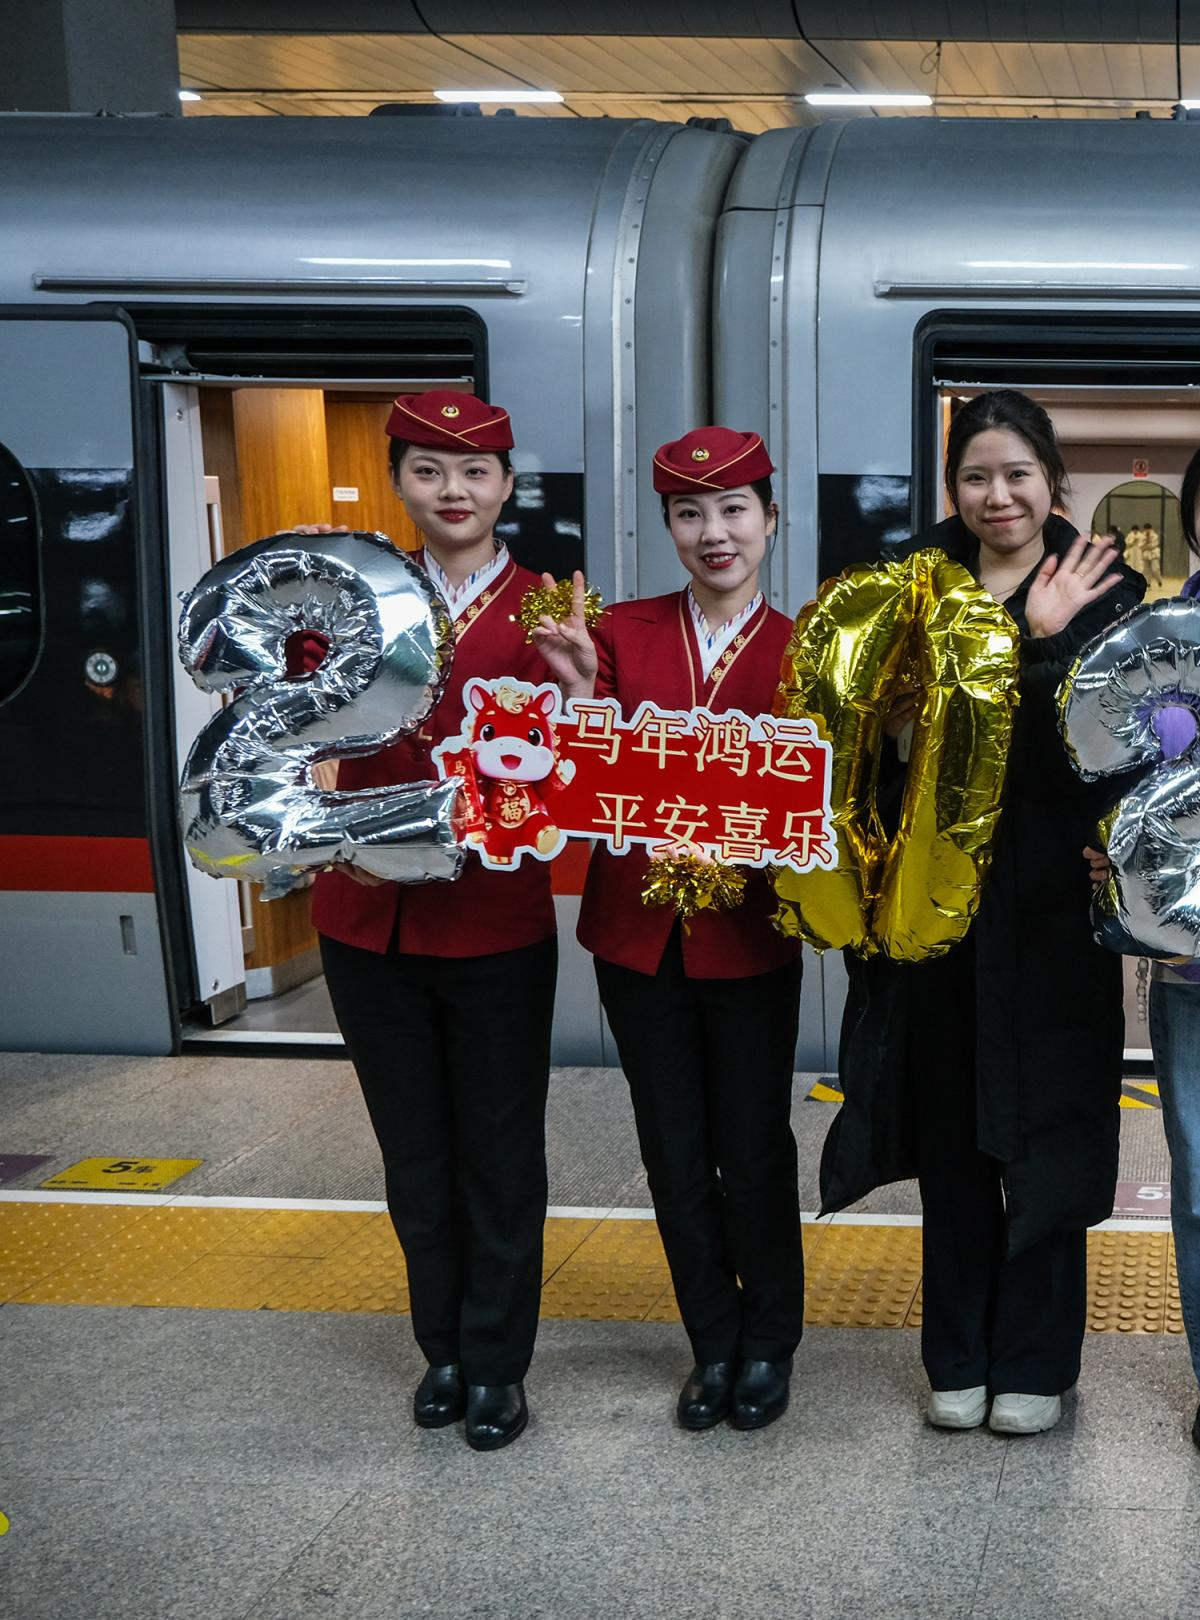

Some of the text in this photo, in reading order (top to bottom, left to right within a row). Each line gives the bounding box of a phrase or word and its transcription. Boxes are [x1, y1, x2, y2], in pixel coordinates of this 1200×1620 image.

[568, 704, 814, 783] 马年鸿运
[500, 796, 524, 824] 福
[592, 792, 832, 866] 平安喜乐
